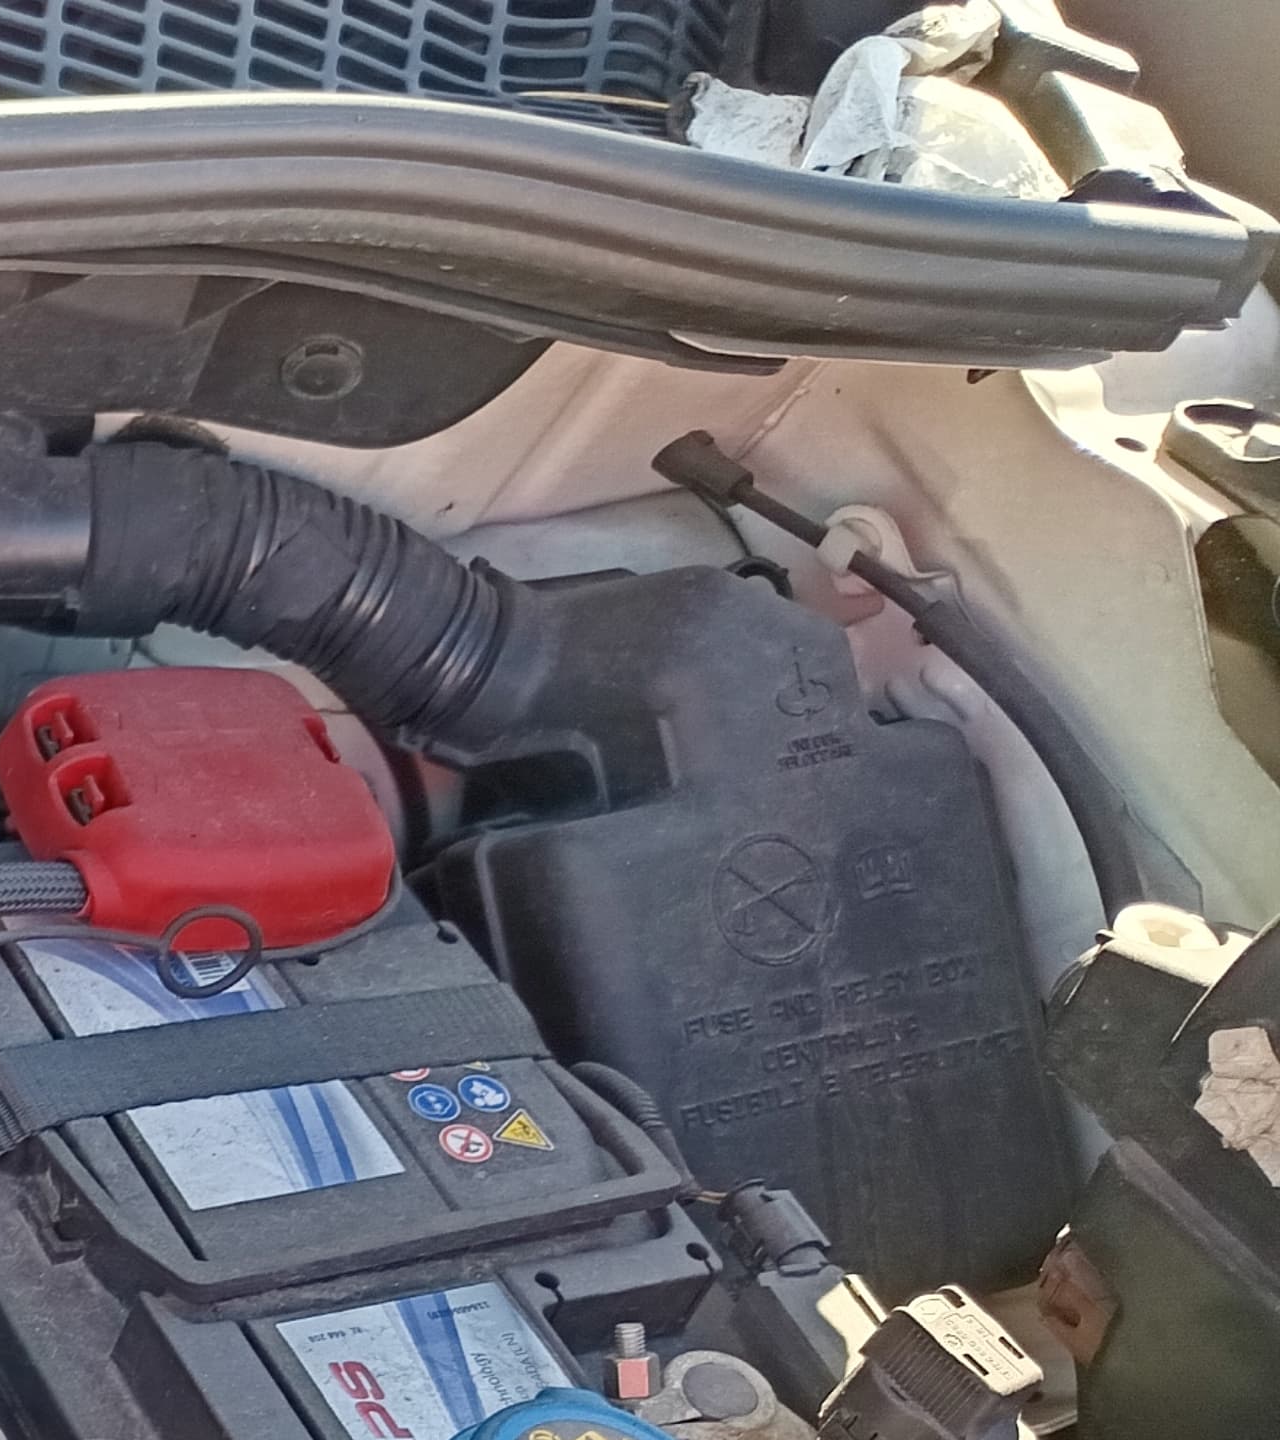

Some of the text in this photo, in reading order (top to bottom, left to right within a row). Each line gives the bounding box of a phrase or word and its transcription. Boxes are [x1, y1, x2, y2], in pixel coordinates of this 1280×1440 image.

[682, 1006, 756, 1043] FUSE
[769, 990, 818, 1024] AND
[924, 954, 979, 988] BOX
